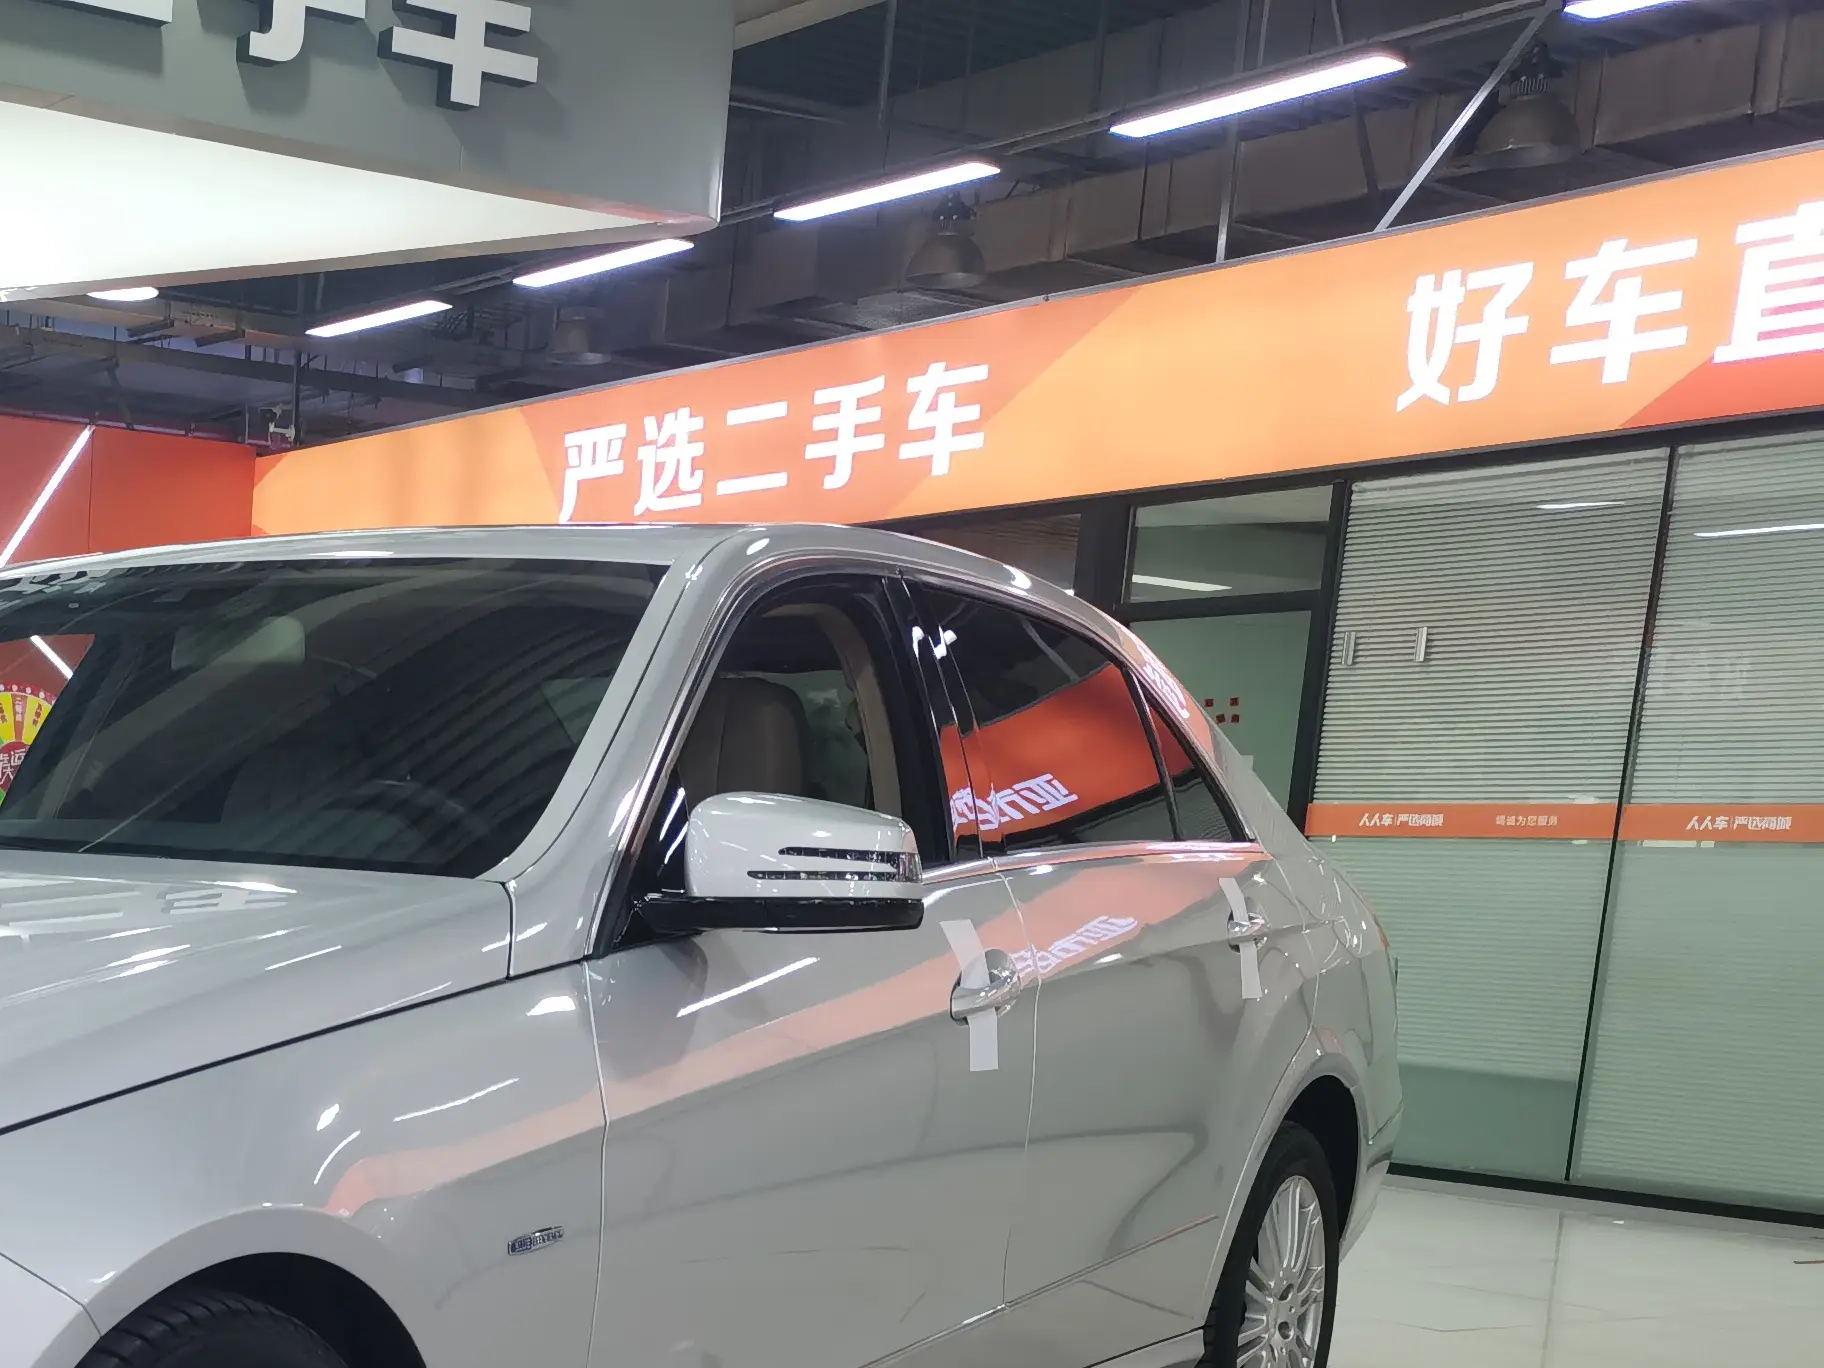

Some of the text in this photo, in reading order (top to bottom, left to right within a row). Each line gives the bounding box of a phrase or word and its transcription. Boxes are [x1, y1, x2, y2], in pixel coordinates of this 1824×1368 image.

[1396, 200, 1824, 412] 好车直
[559, 362, 988, 524] 严选二手车
[1359, 813, 1393, 826] 人人车
[1686, 815, 1729, 830] 人人车
